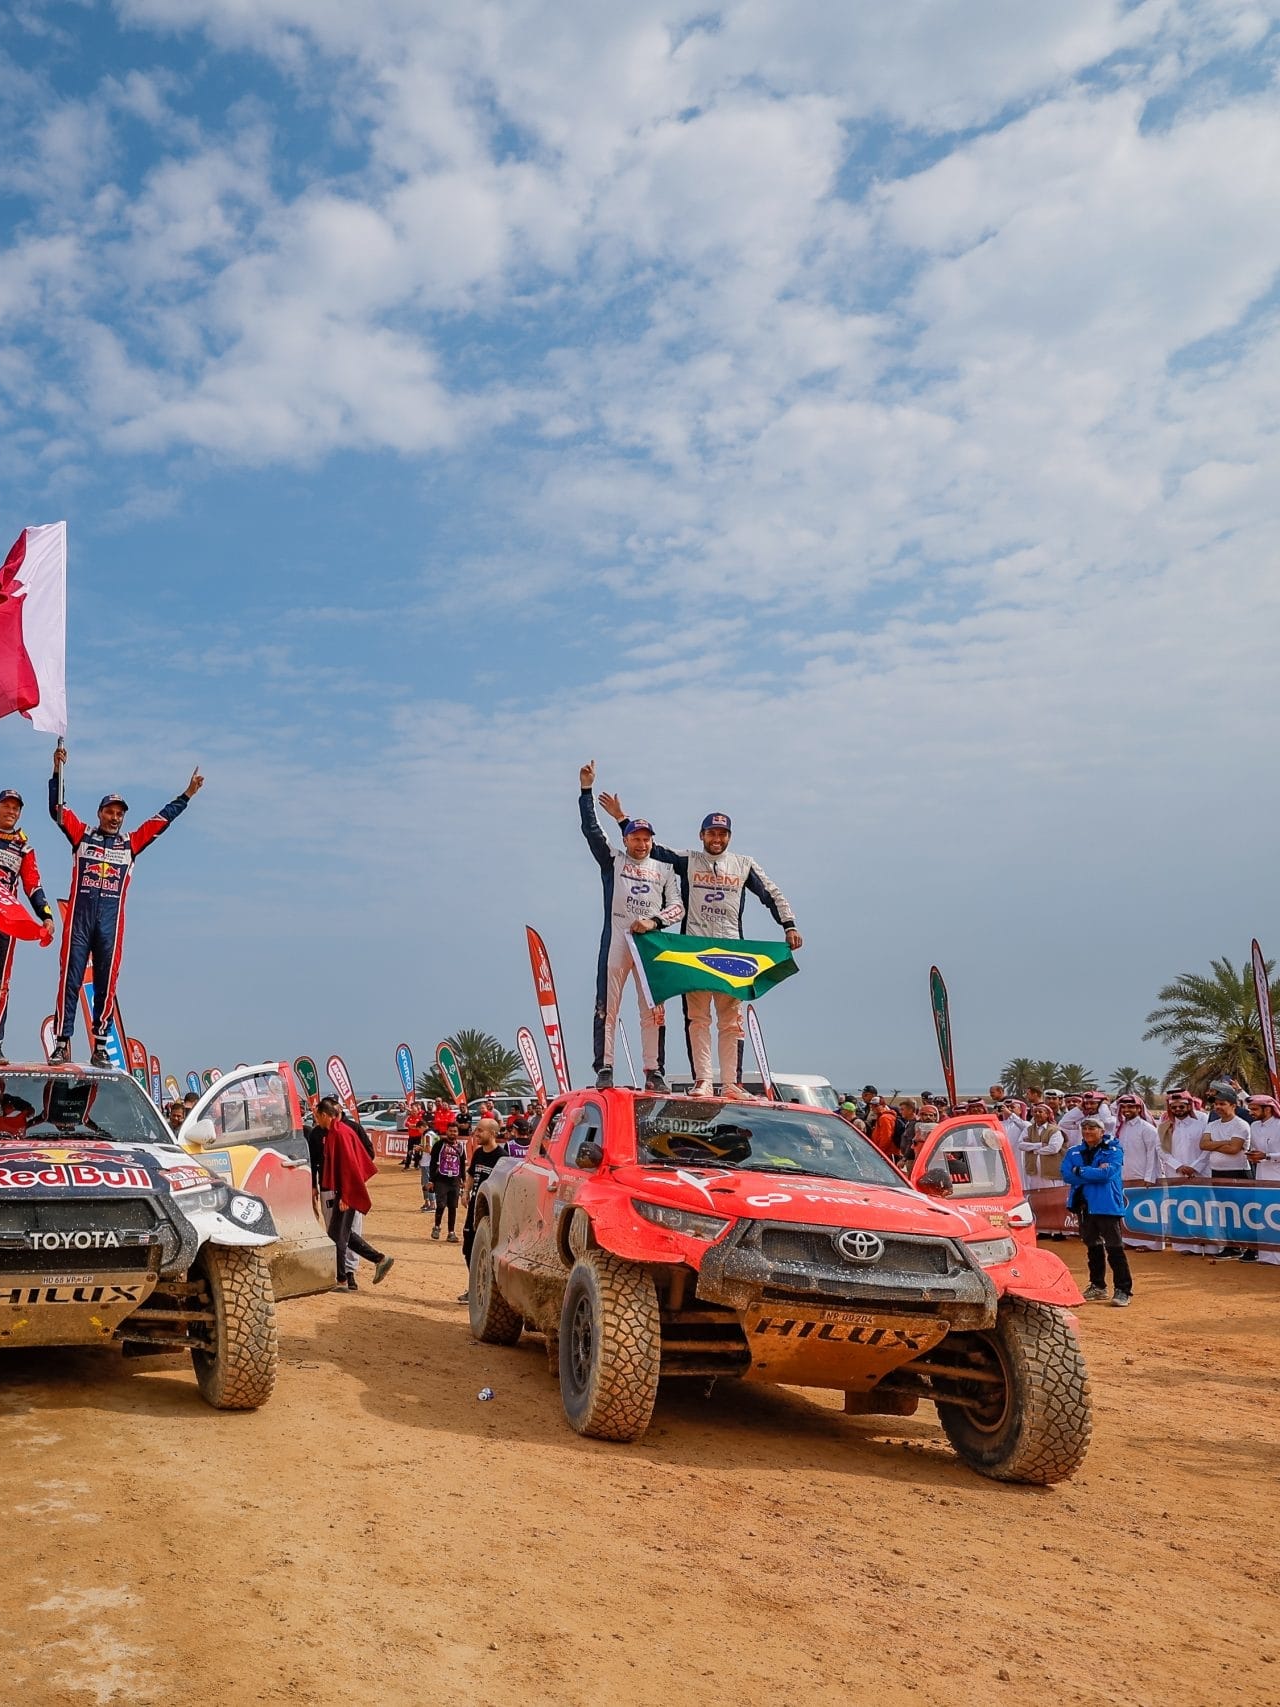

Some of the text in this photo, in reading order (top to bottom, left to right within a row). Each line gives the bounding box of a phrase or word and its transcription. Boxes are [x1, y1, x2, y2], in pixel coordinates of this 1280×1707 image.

[82, 876, 119, 891] Red Bull
[626, 896, 651, 907] Pneu
[626, 905, 650, 916] Store
[701, 905, 726, 916] Pneu
[521, 1037, 540, 1083] MOTUL
[78, 1074, 119, 1082] acing
[400, 1049, 412, 1090] aramco
[331, 1064, 349, 1095] MOTUL
[387, 1138, 408, 1151] MOTU
[72, 1165, 153, 1189] Bull
[30, 1231, 120, 1250] TOYOTA
[755, 1317, 929, 1350] HILUX
